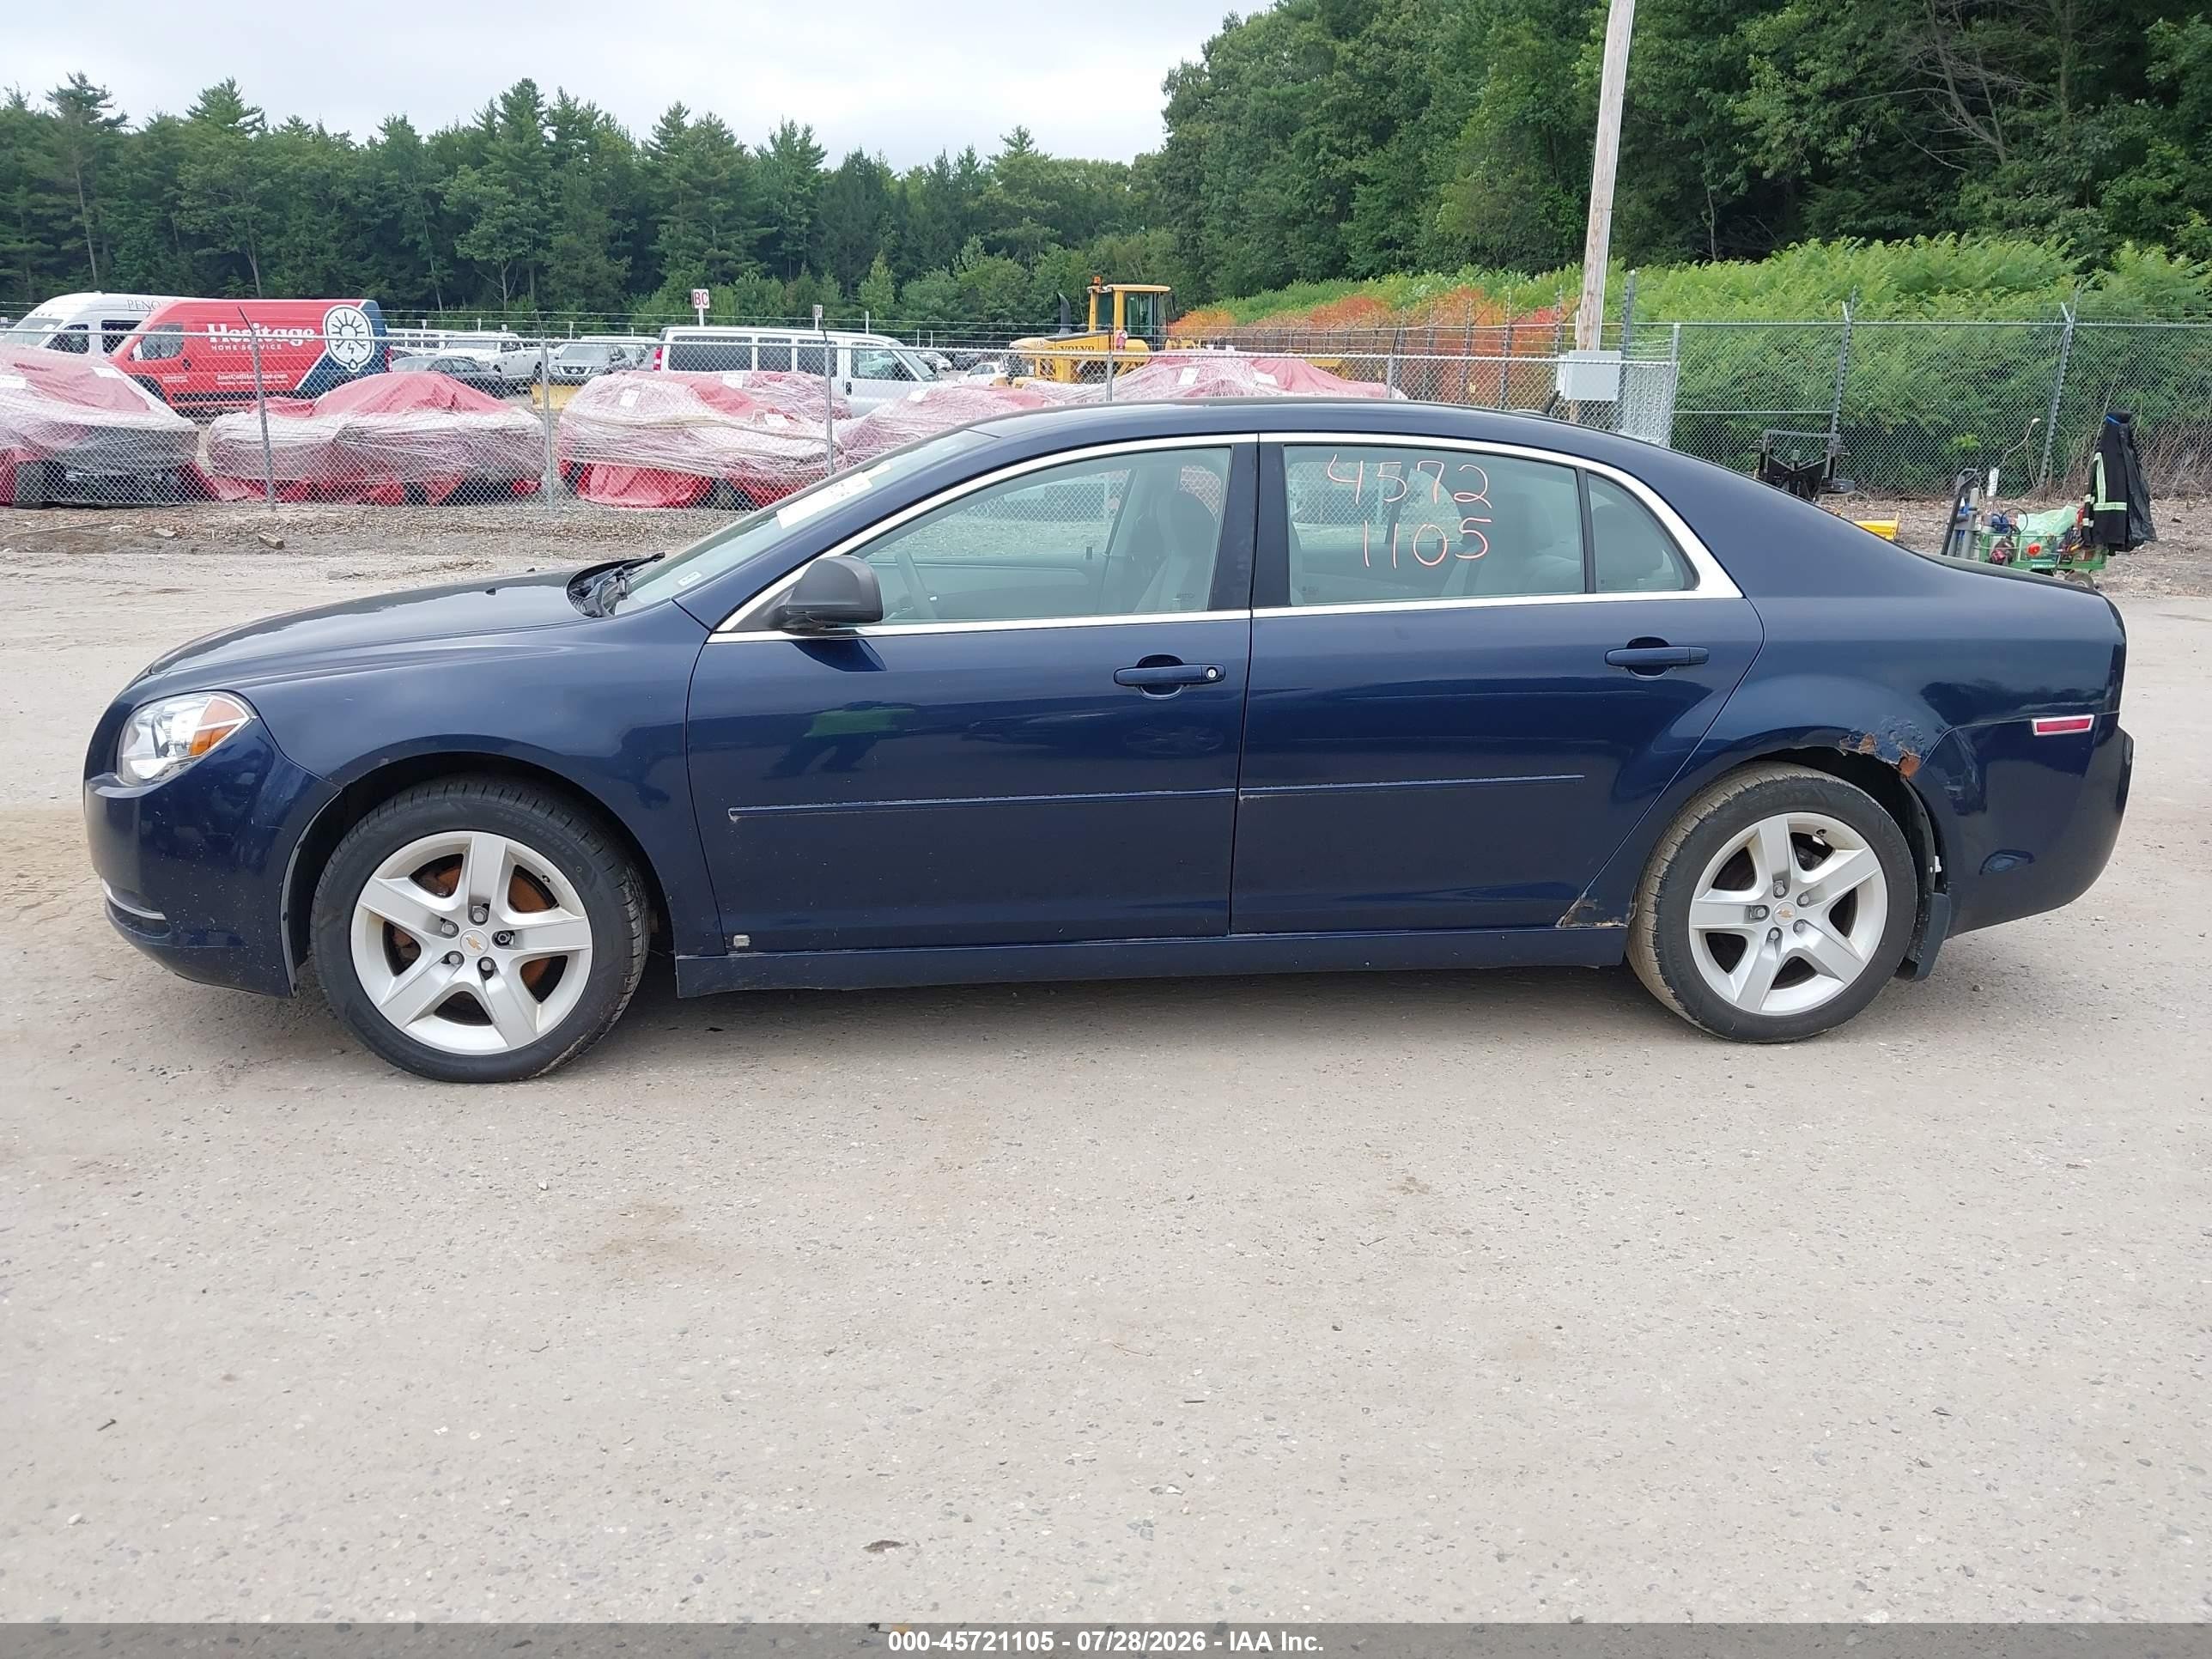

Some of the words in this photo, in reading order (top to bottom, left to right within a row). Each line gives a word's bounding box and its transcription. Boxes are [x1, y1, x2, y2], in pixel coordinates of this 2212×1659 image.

[694, 291, 708, 306] BC
[207, 323, 315, 346] Heritage
[1328, 453, 1492, 508] 4572
[1364, 517, 1492, 568] 1105
